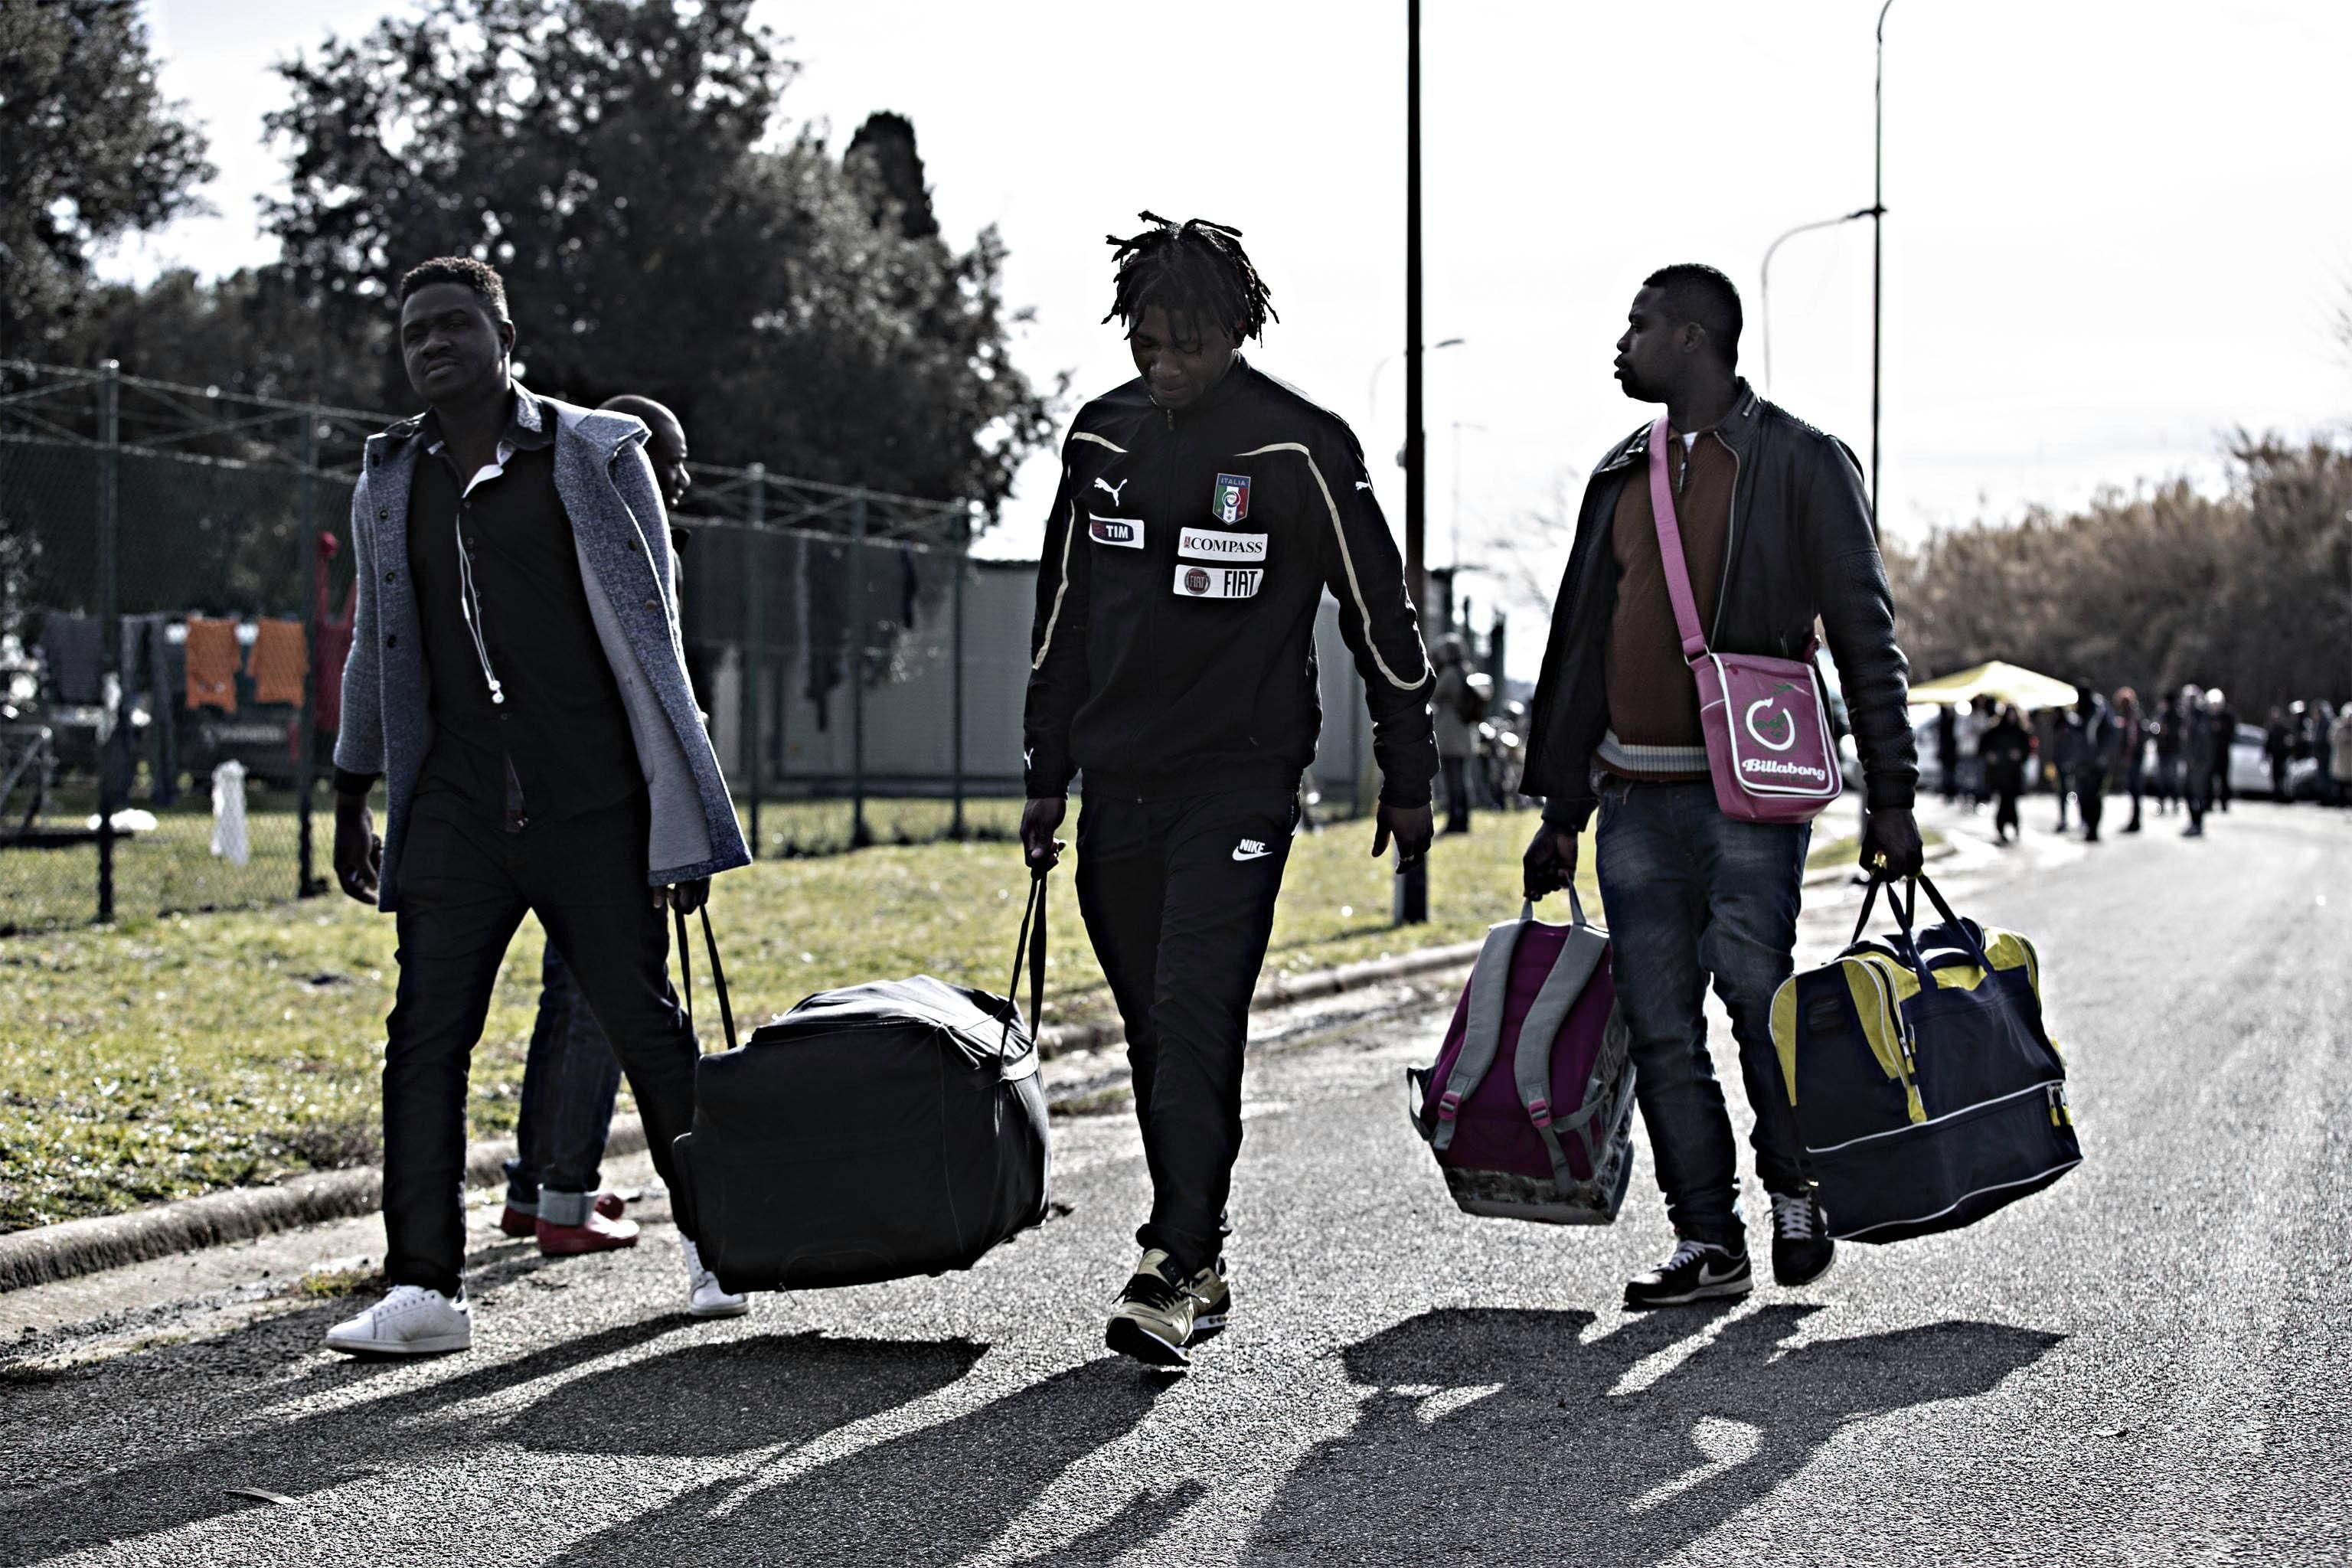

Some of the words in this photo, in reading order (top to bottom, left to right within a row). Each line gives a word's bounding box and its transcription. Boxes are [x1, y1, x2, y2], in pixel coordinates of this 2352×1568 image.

[1220, 478, 1246, 486] ITALIA
[1106, 525, 1129, 539] TIM
[1191, 537, 1263, 553] COMPASS
[1190, 575, 1205, 589] FIAT
[1223, 570, 1258, 596] FIAT
[1742, 759, 1825, 781] Billabong
[1240, 839, 1266, 854] NIKE
